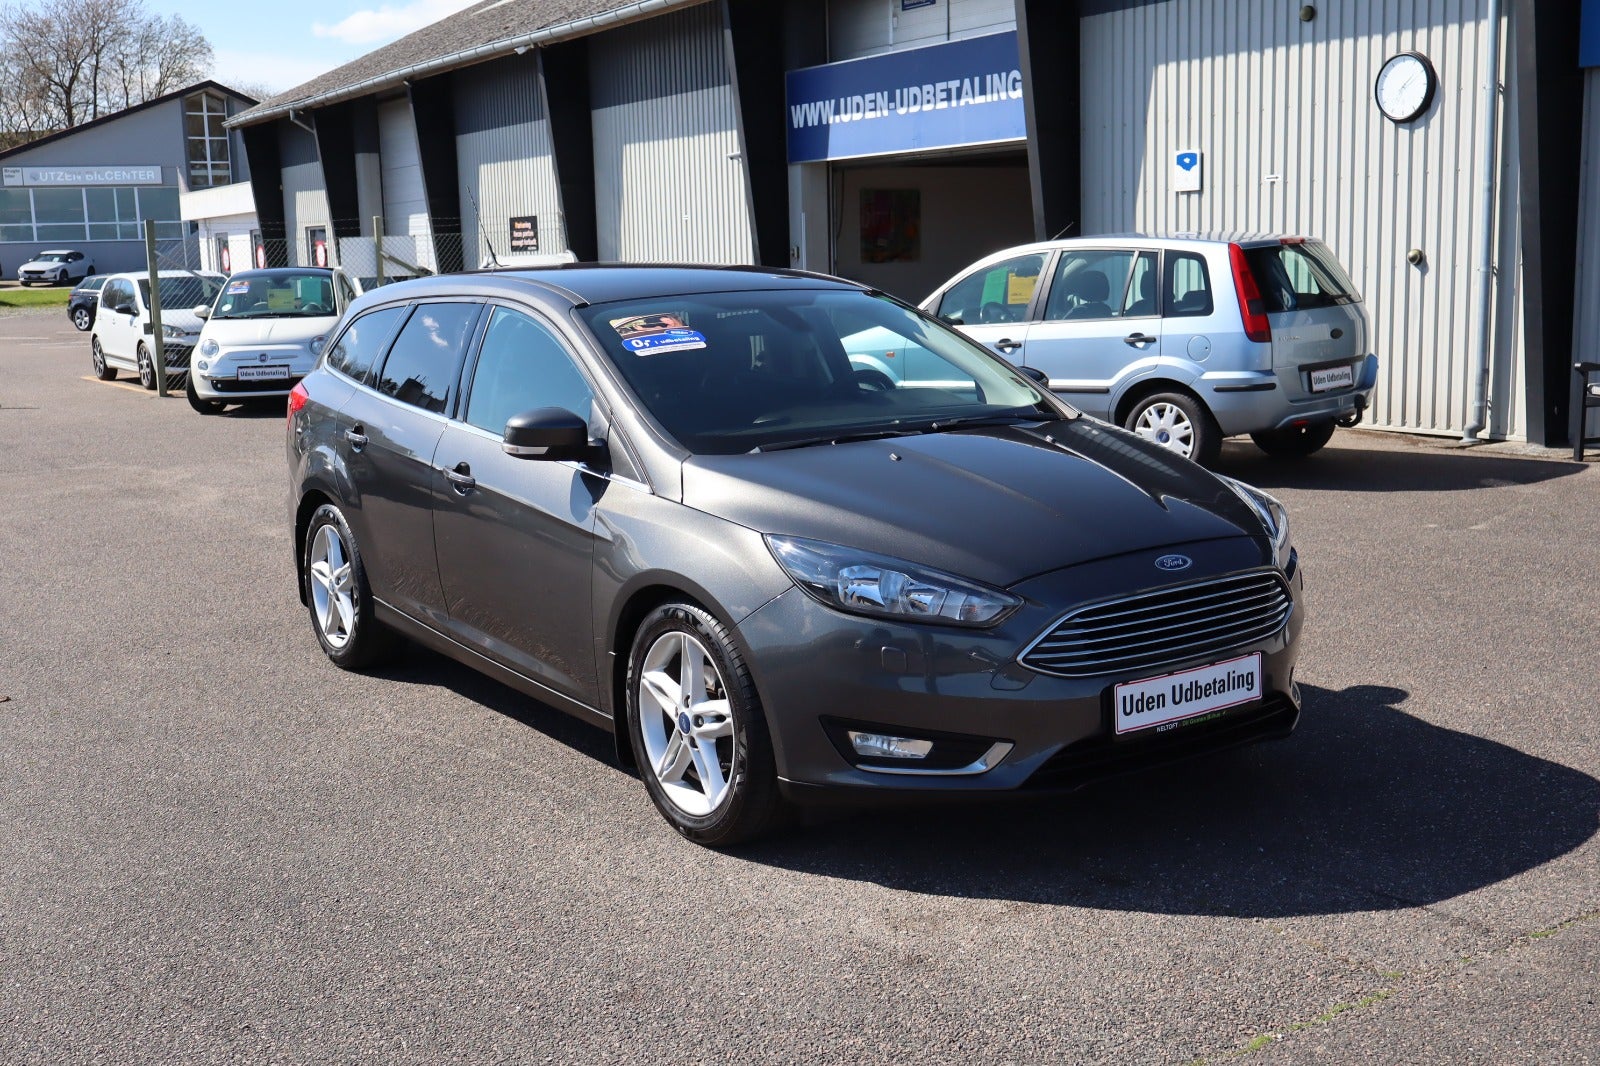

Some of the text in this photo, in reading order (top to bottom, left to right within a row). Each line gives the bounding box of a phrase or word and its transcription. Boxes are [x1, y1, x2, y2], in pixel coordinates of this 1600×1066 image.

[790, 69, 1023, 129] WWW.UDEN-UDBETALING
[1122, 670, 1255, 717] Uden Udbetaling
